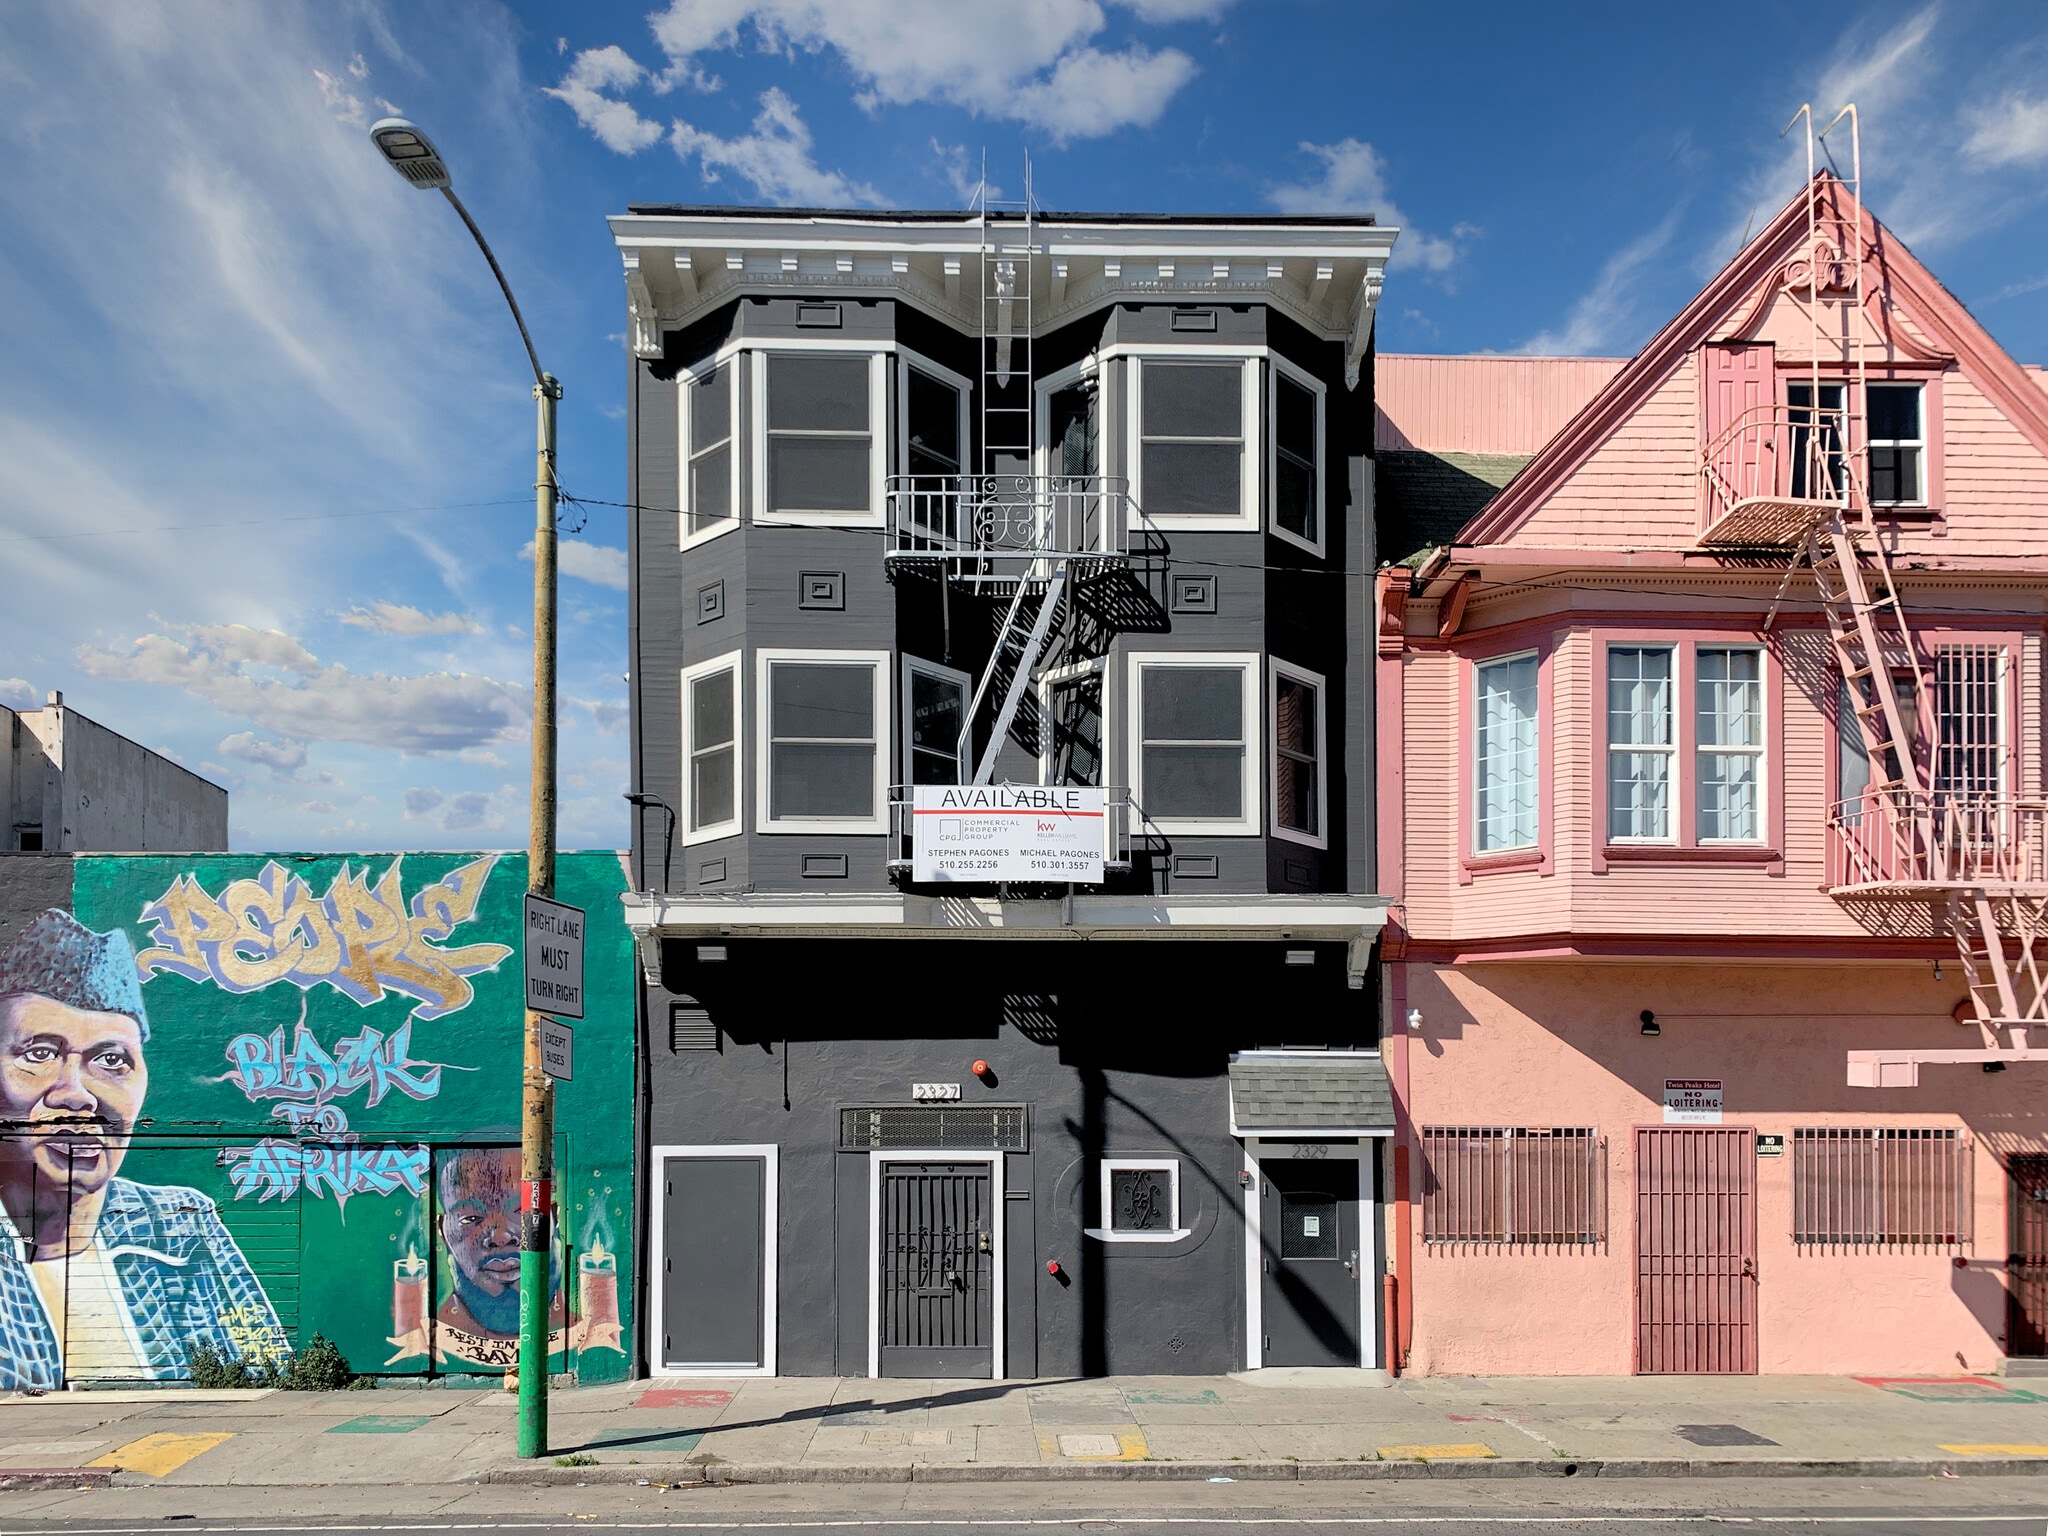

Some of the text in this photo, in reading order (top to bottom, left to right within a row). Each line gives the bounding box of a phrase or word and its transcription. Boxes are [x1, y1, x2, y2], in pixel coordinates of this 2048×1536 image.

[942, 789, 1080, 809] AVAILABLE
[1037, 819, 1056, 832] kw
[927, 848, 1010, 857] STEPHEN PAGONES
[1019, 849, 1100, 859] MICHAEL PAGONES
[939, 860, 998, 869] 510.255.2256
[1030, 860, 1089, 870] 510.301.3557
[530, 910, 580, 940] RIGHT LANE
[136, 856, 513, 1020] PEOPLE
[541, 945, 570, 972] MUST
[531, 978, 579, 1004] TURN RIGHT
[545, 1032, 567, 1049] EXCEPT
[226, 1020, 441, 1108] BLACK
[546, 1050, 565, 1067] BUSES
[915, 1084, 959, 1099] 2327
[1685, 1081, 1702, 1089] Peaks
[1703, 1081, 1720, 1089] Hotel
[1669, 1098, 1719, 1108] LOITERING
[272, 1102, 348, 1135] TO
[1765, 1136, 1775, 1145] NO
[1292, 1144, 1329, 1159] 2329
[226, 1136, 430, 1203] AFRIKA
[445, 1328, 515, 1350] REST IN
